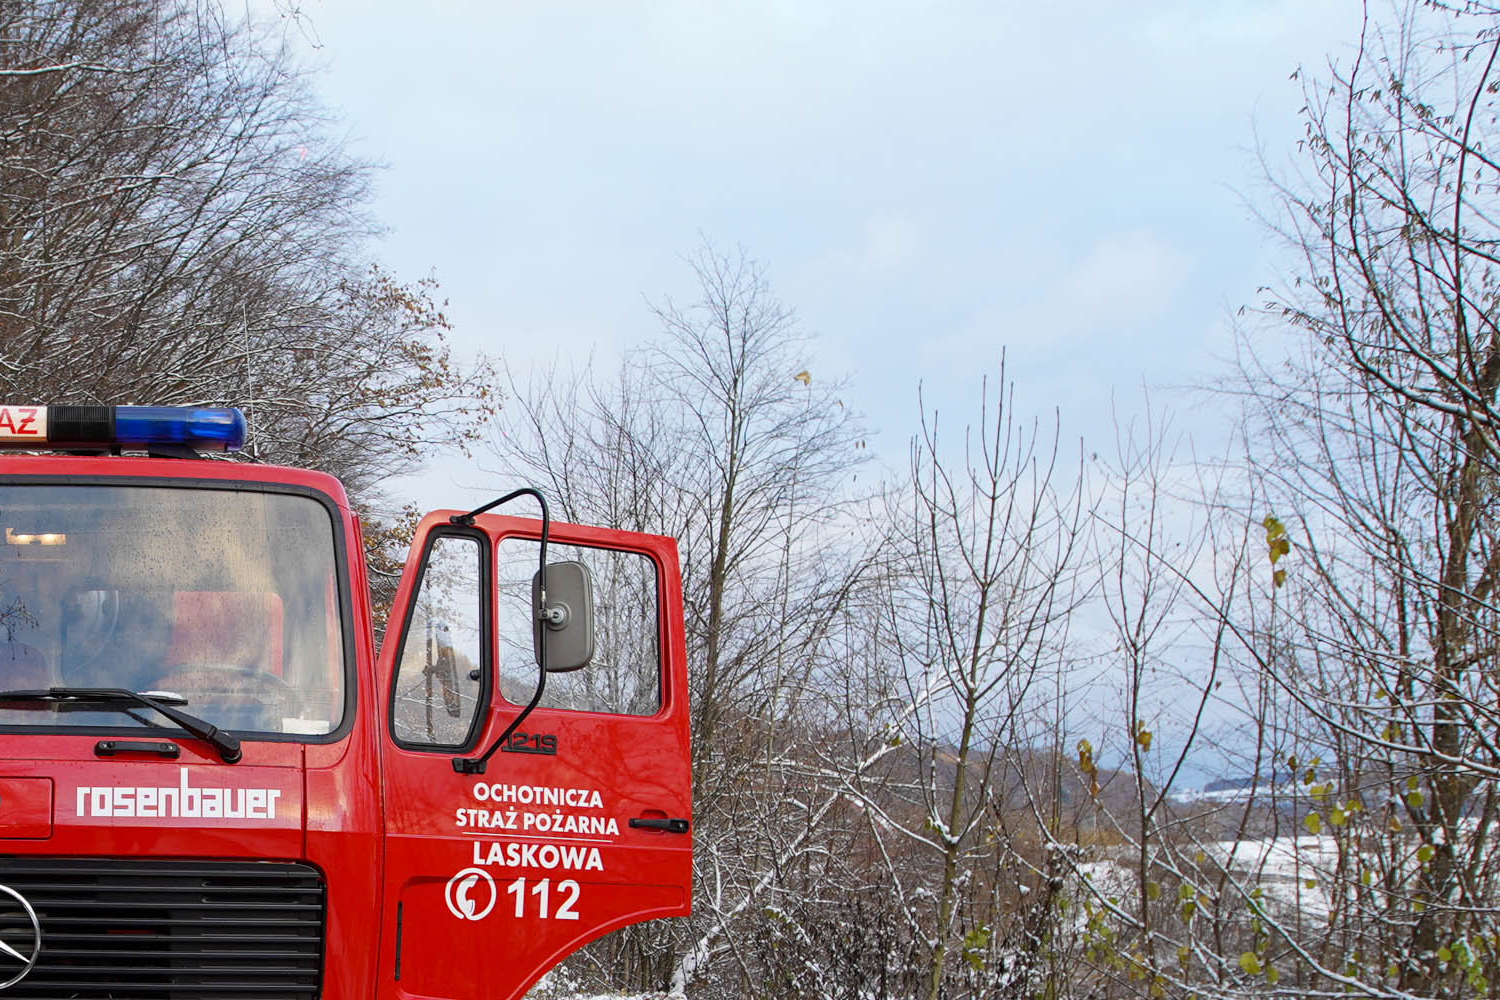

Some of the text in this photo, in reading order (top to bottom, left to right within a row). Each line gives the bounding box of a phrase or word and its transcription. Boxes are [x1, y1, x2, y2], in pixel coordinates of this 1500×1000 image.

[506, 732, 557, 752] 1219
[76, 767, 281, 819] rosenbauer
[473, 782, 604, 809] OCHOTNICZA
[455, 806, 620, 836] STRAŻ POŻARNA
[472, 841, 604, 871] LASKOWA
[507, 876, 580, 920] 112
